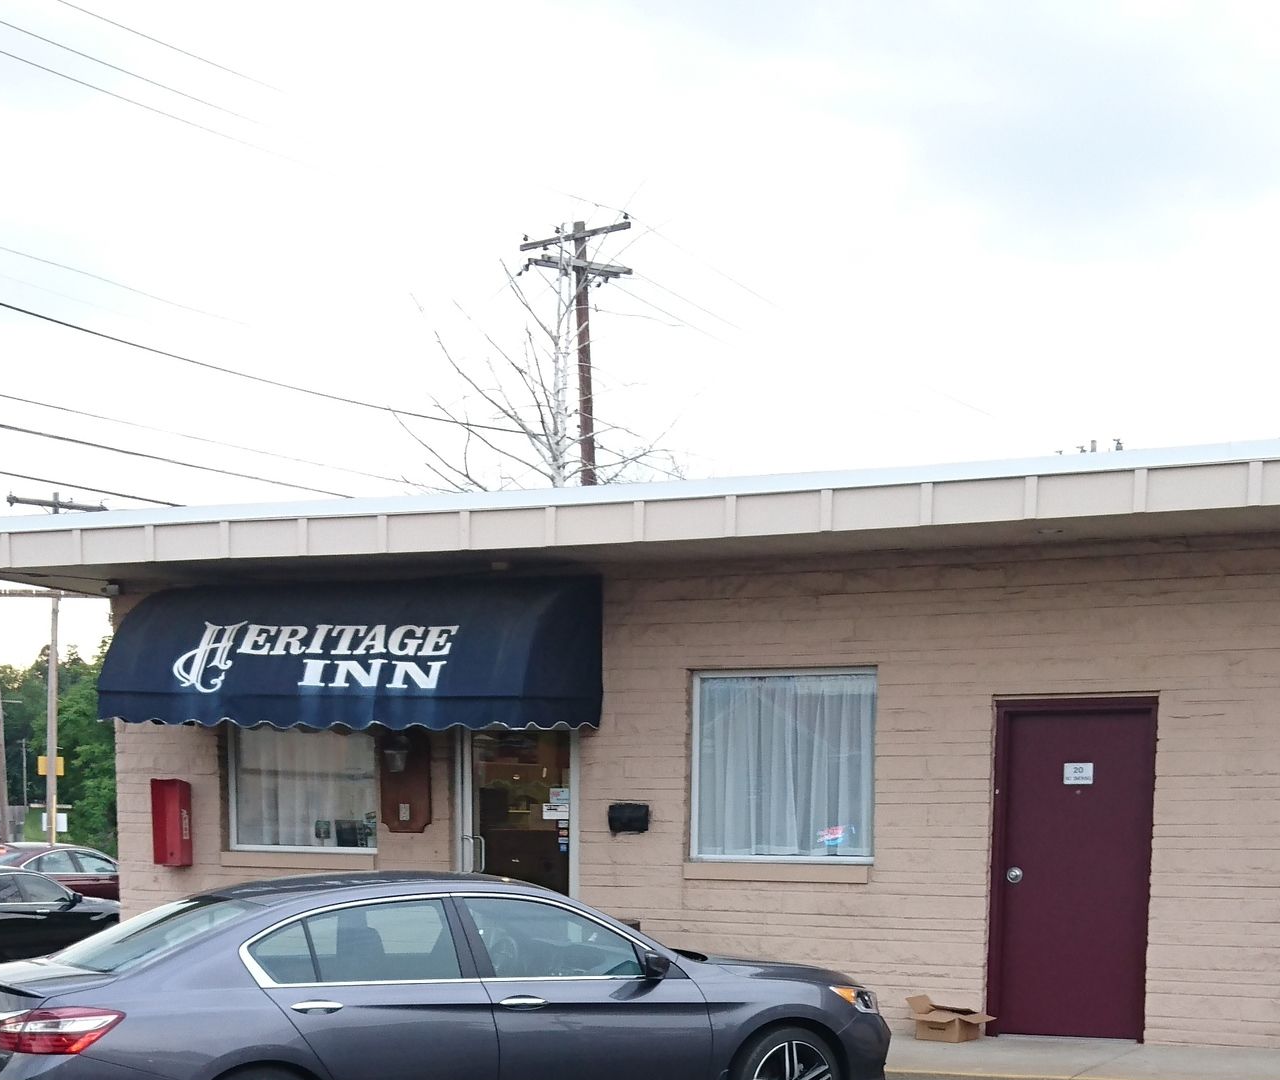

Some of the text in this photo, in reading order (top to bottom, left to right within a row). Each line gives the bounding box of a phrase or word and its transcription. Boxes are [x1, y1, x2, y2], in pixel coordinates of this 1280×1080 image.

[173, 620, 460, 693] HERITAGE
[297, 658, 448, 689] INN
[1073, 766, 1084, 774] 20
